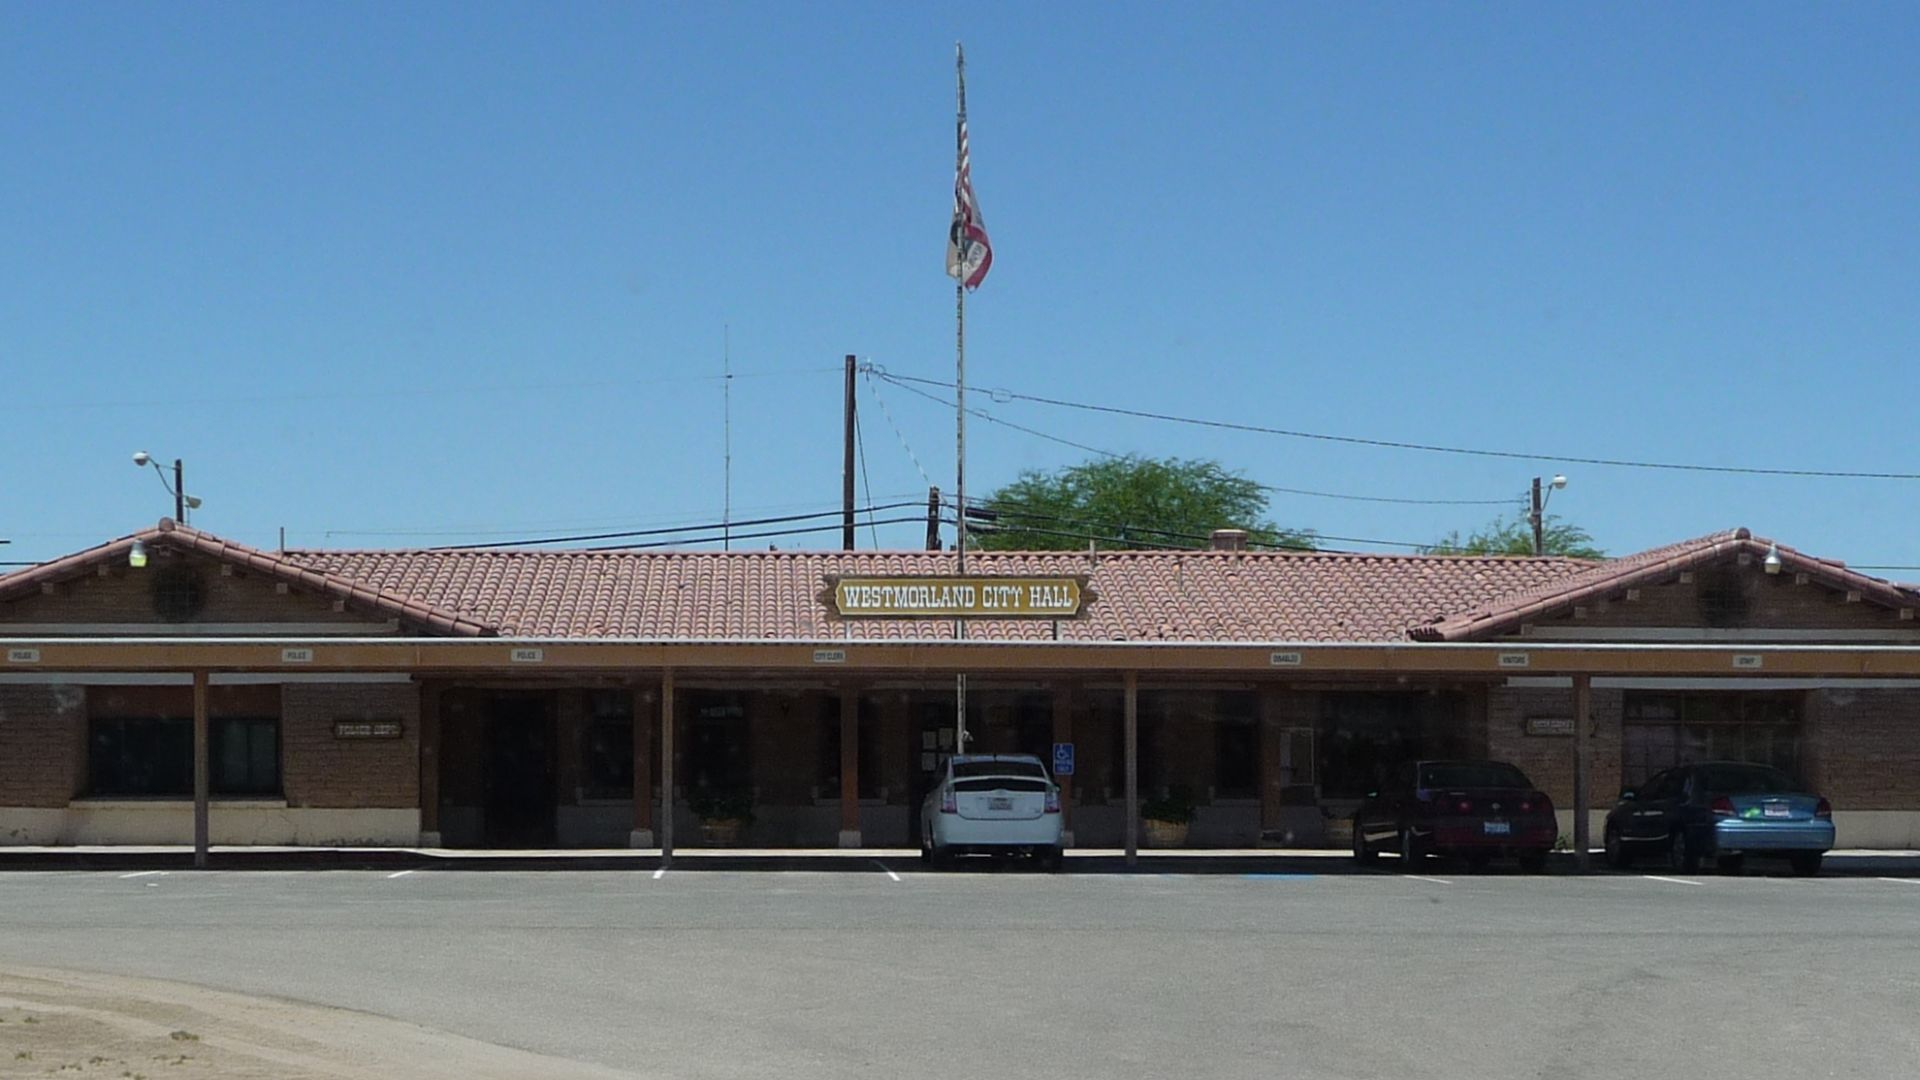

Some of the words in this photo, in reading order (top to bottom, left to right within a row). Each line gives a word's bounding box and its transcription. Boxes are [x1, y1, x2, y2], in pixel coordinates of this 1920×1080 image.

[843, 585, 975, 608] WESTMORLAND
[982, 585, 1023, 608] CITY
[1029, 585, 1073, 608] HALL
